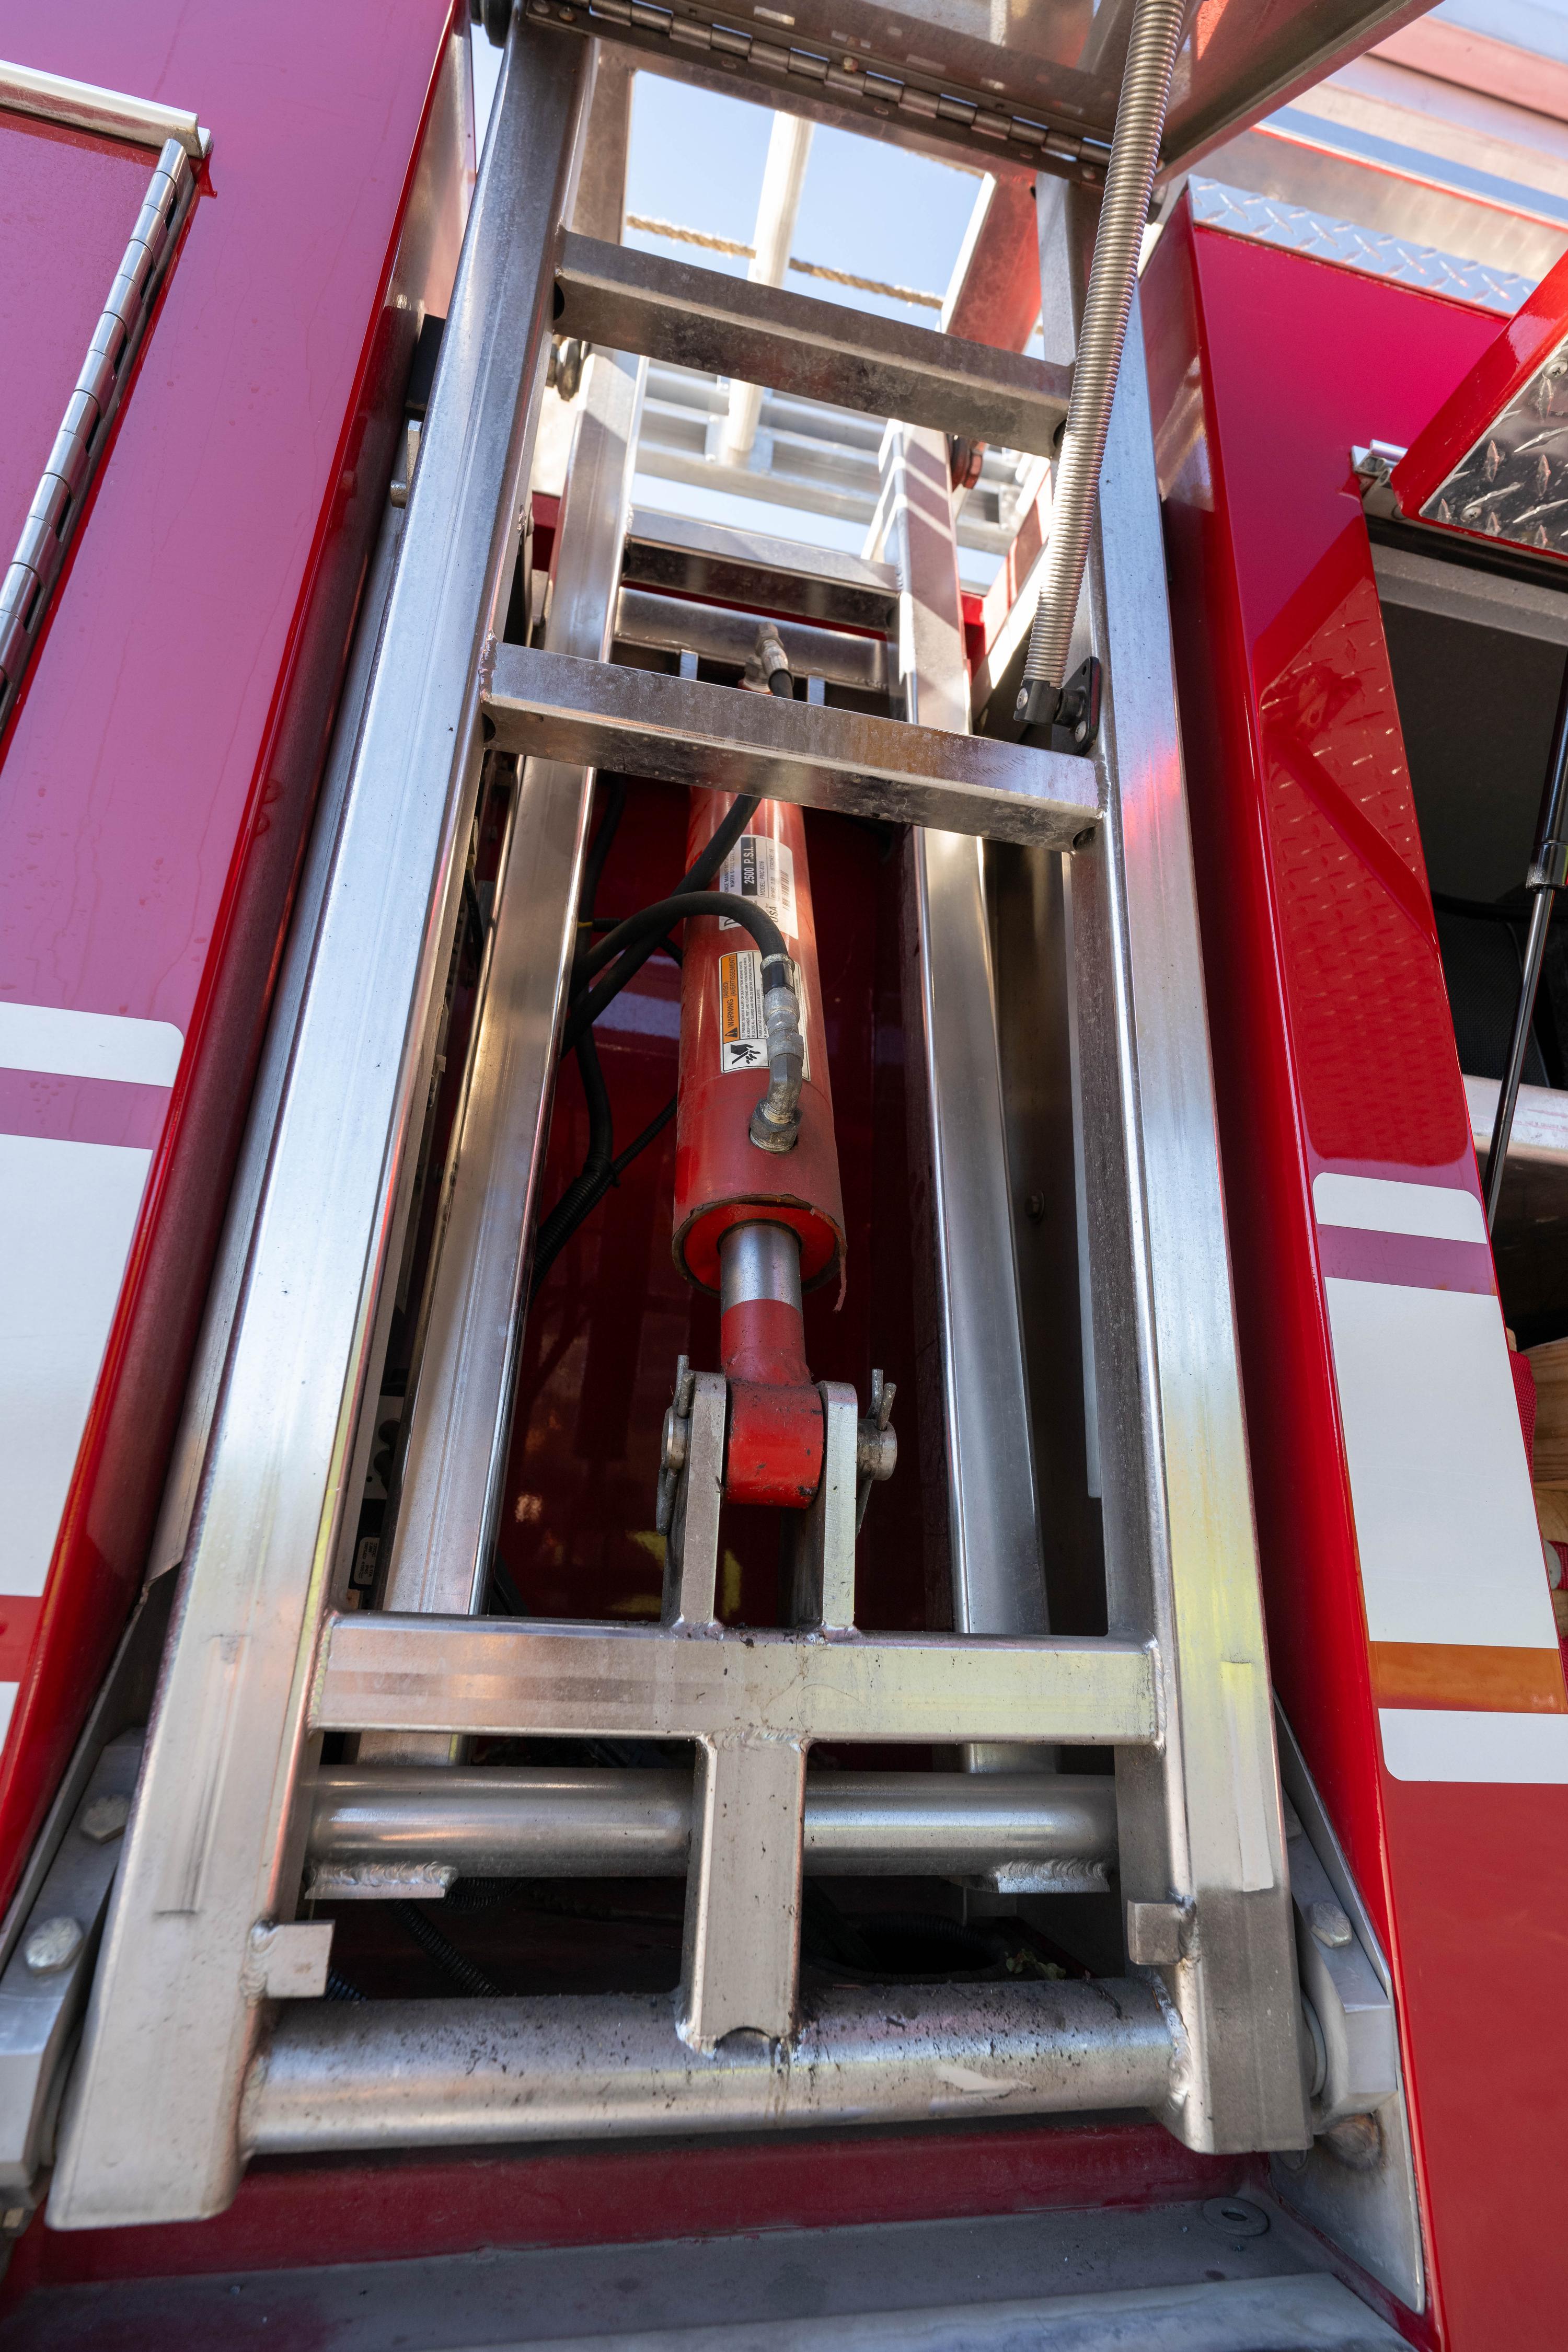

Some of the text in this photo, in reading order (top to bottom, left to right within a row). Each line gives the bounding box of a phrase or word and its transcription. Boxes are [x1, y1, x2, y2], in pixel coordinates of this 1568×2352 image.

[743, 847, 755, 884] 2500 P.S.I.
[769, 906, 778, 923] USA
[729, 955, 737, 996] (AVERTISSEMENT)
